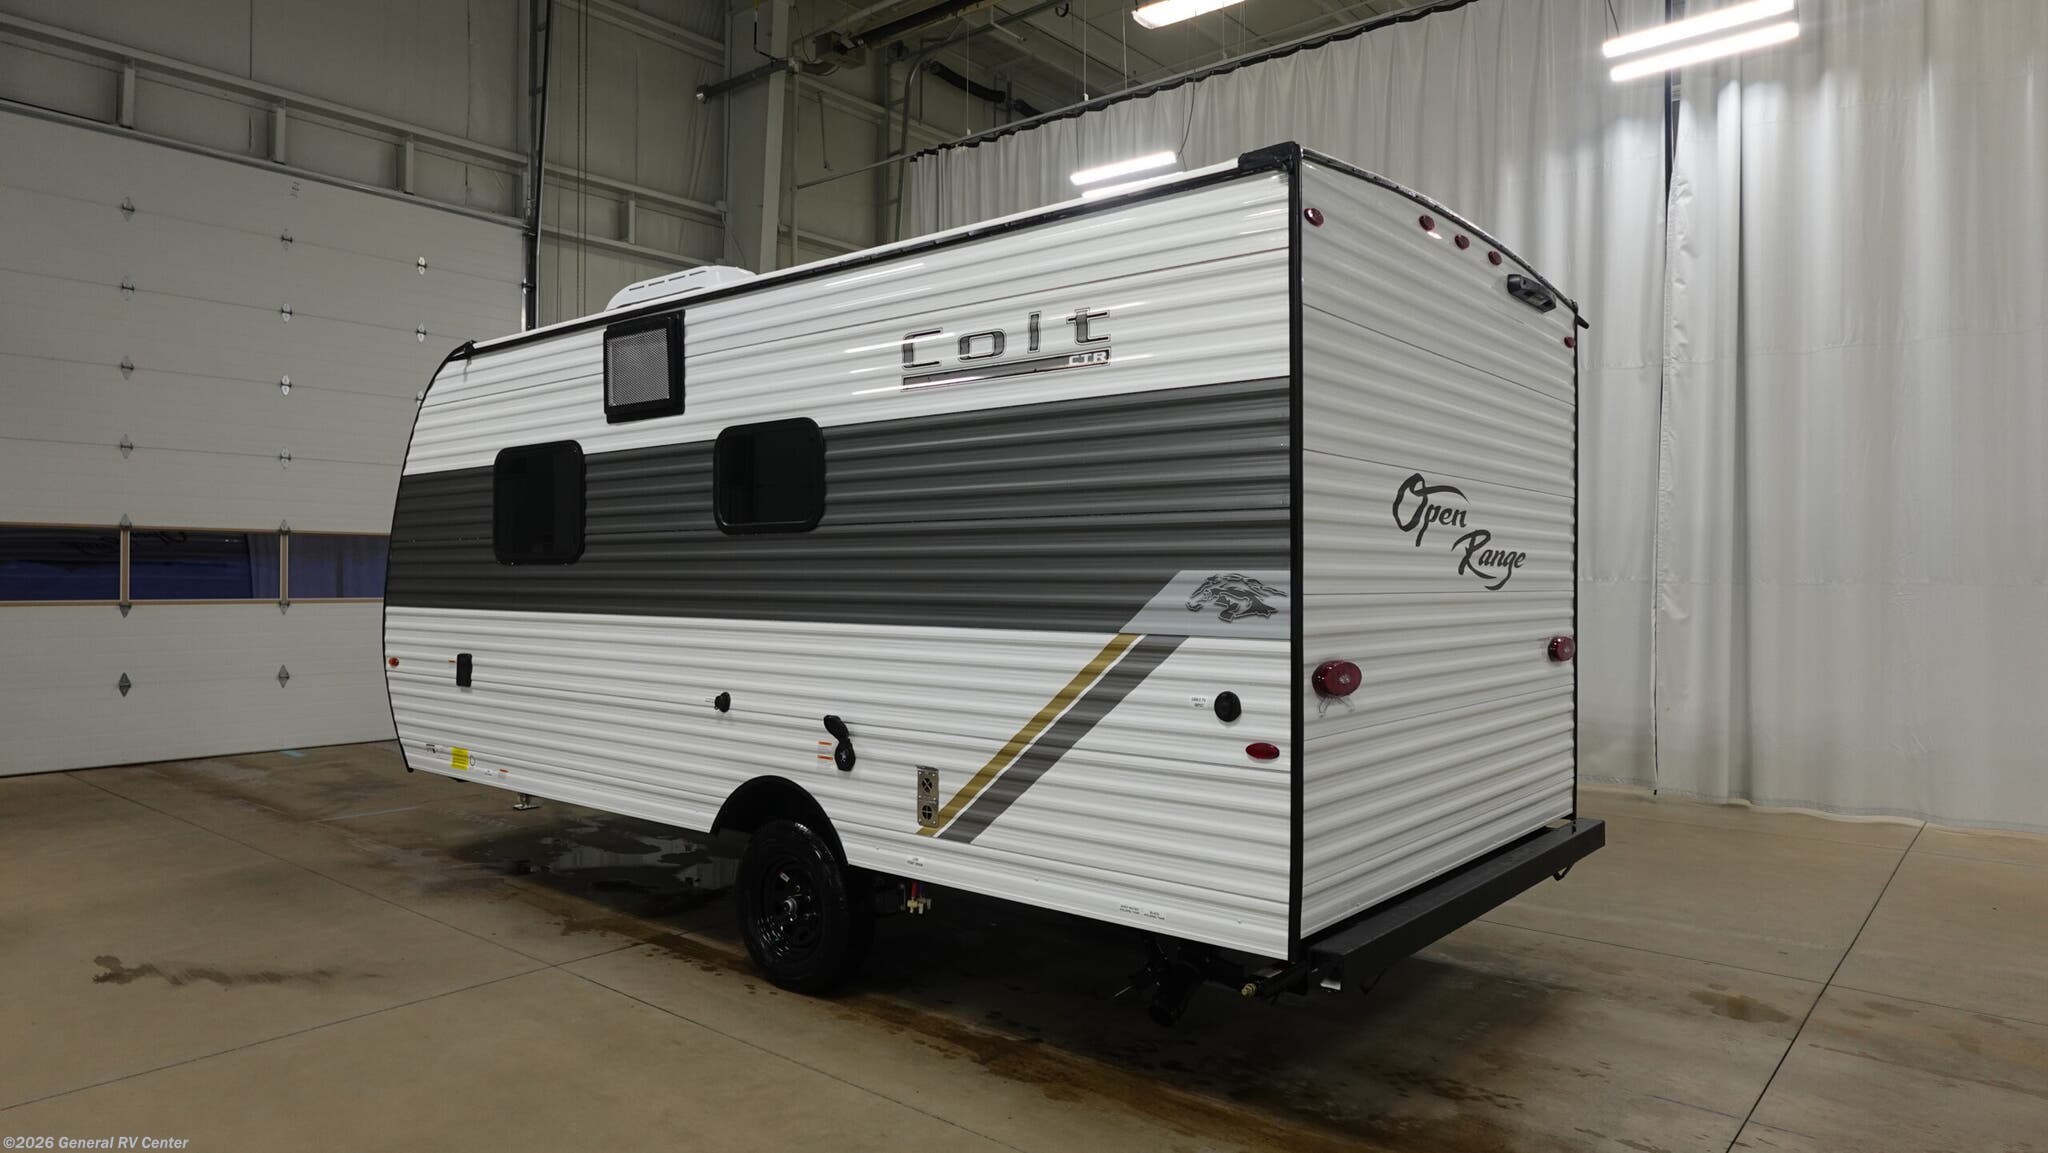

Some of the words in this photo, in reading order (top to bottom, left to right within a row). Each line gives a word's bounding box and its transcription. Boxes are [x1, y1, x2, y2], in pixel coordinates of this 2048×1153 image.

[901, 307, 1110, 369] Colt
[1069, 351, 1108, 366] CTR
[1392, 472, 1471, 548] Open
[1450, 529, 1527, 591] Range
